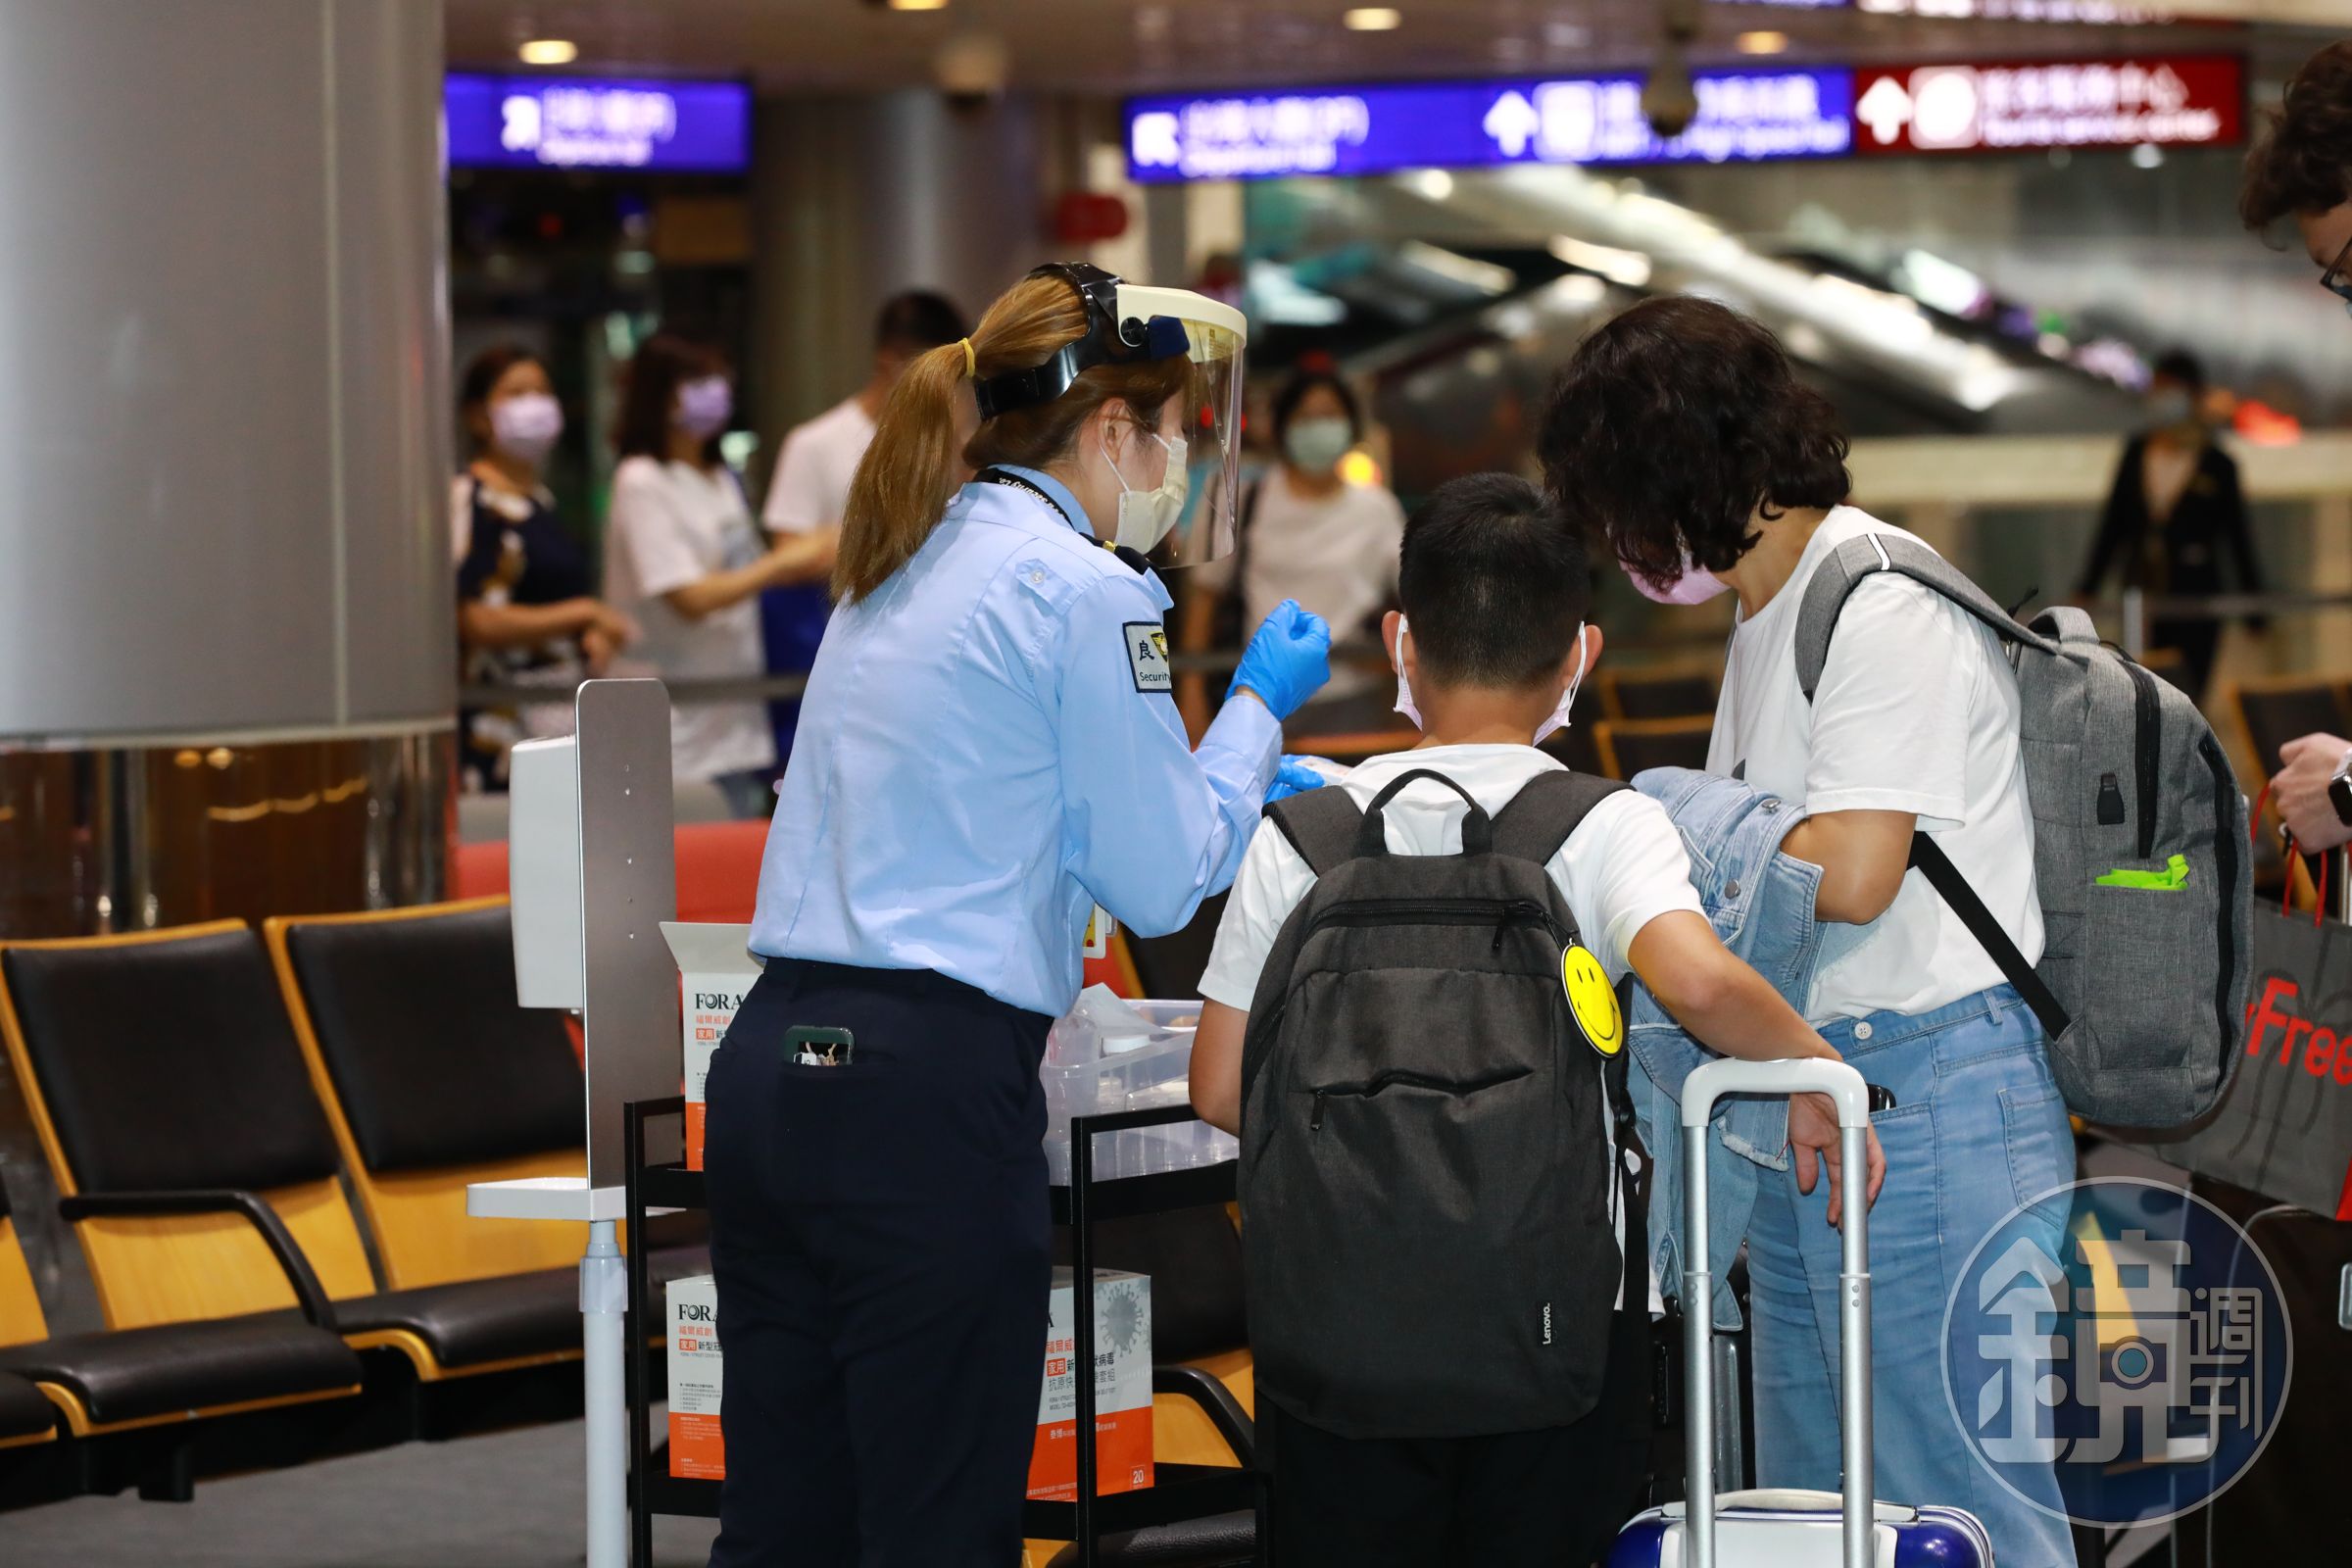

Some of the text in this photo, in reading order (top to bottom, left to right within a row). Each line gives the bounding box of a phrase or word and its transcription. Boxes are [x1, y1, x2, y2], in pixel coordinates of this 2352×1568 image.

[1139, 640, 1155, 662] 良
[1140, 671, 1171, 684] Security
[695, 993, 742, 1010] FORA
[2245, 976, 2352, 1086] Free
[1543, 1305, 1551, 1345] Lenovo
[1133, 1469, 1145, 1485] 20
